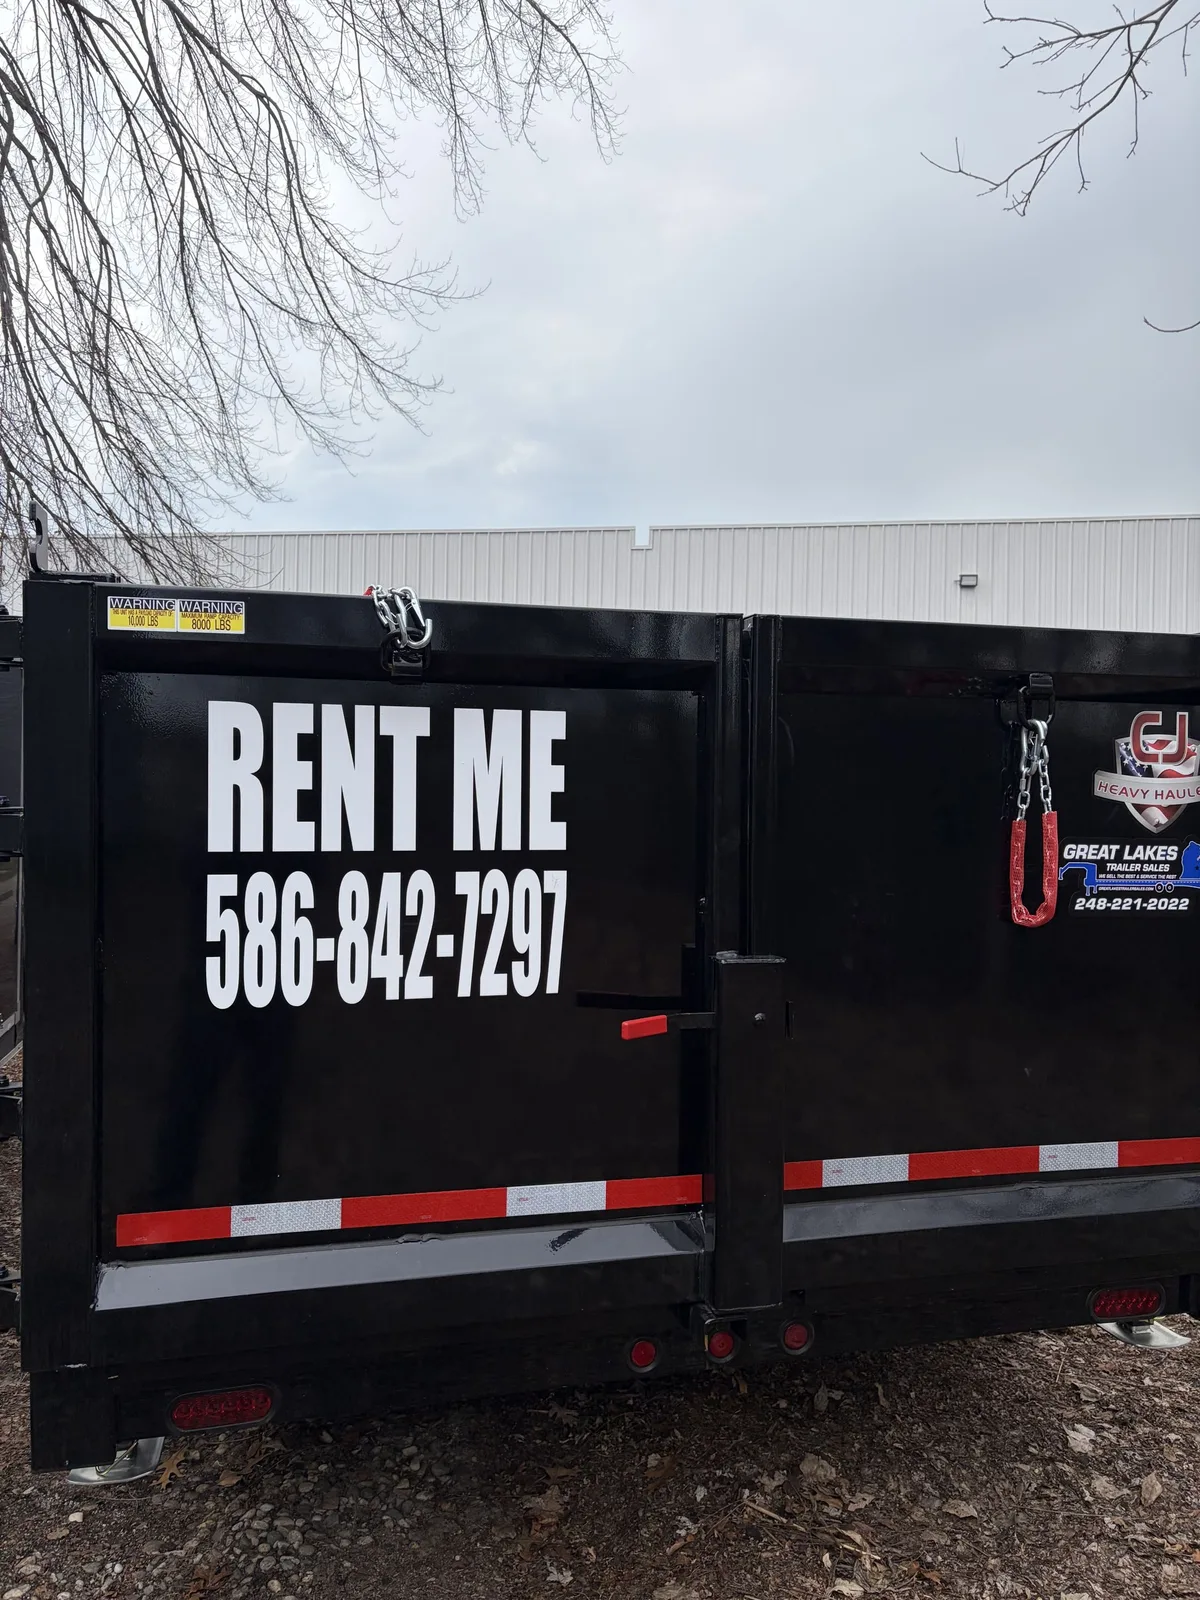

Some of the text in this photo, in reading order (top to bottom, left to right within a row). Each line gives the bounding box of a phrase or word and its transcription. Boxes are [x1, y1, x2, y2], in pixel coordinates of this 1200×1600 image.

[110, 598, 175, 610] WARNING
[180, 601, 243, 614] WARNING
[128, 615, 159, 627] 10,000 LBS
[191, 619, 231, 631] 8000 LBS
[1130, 711, 1189, 765] CJ
[207, 700, 567, 852] RENT ME
[1098, 781, 1150, 800] HEAVY
[1063, 844, 1179, 861] GREAT LAKES
[1106, 863, 1170, 872] TRAILER SALES
[1074, 897, 1190, 911] 248-221-2022
[205, 868, 568, 1010] 586-842-7297
